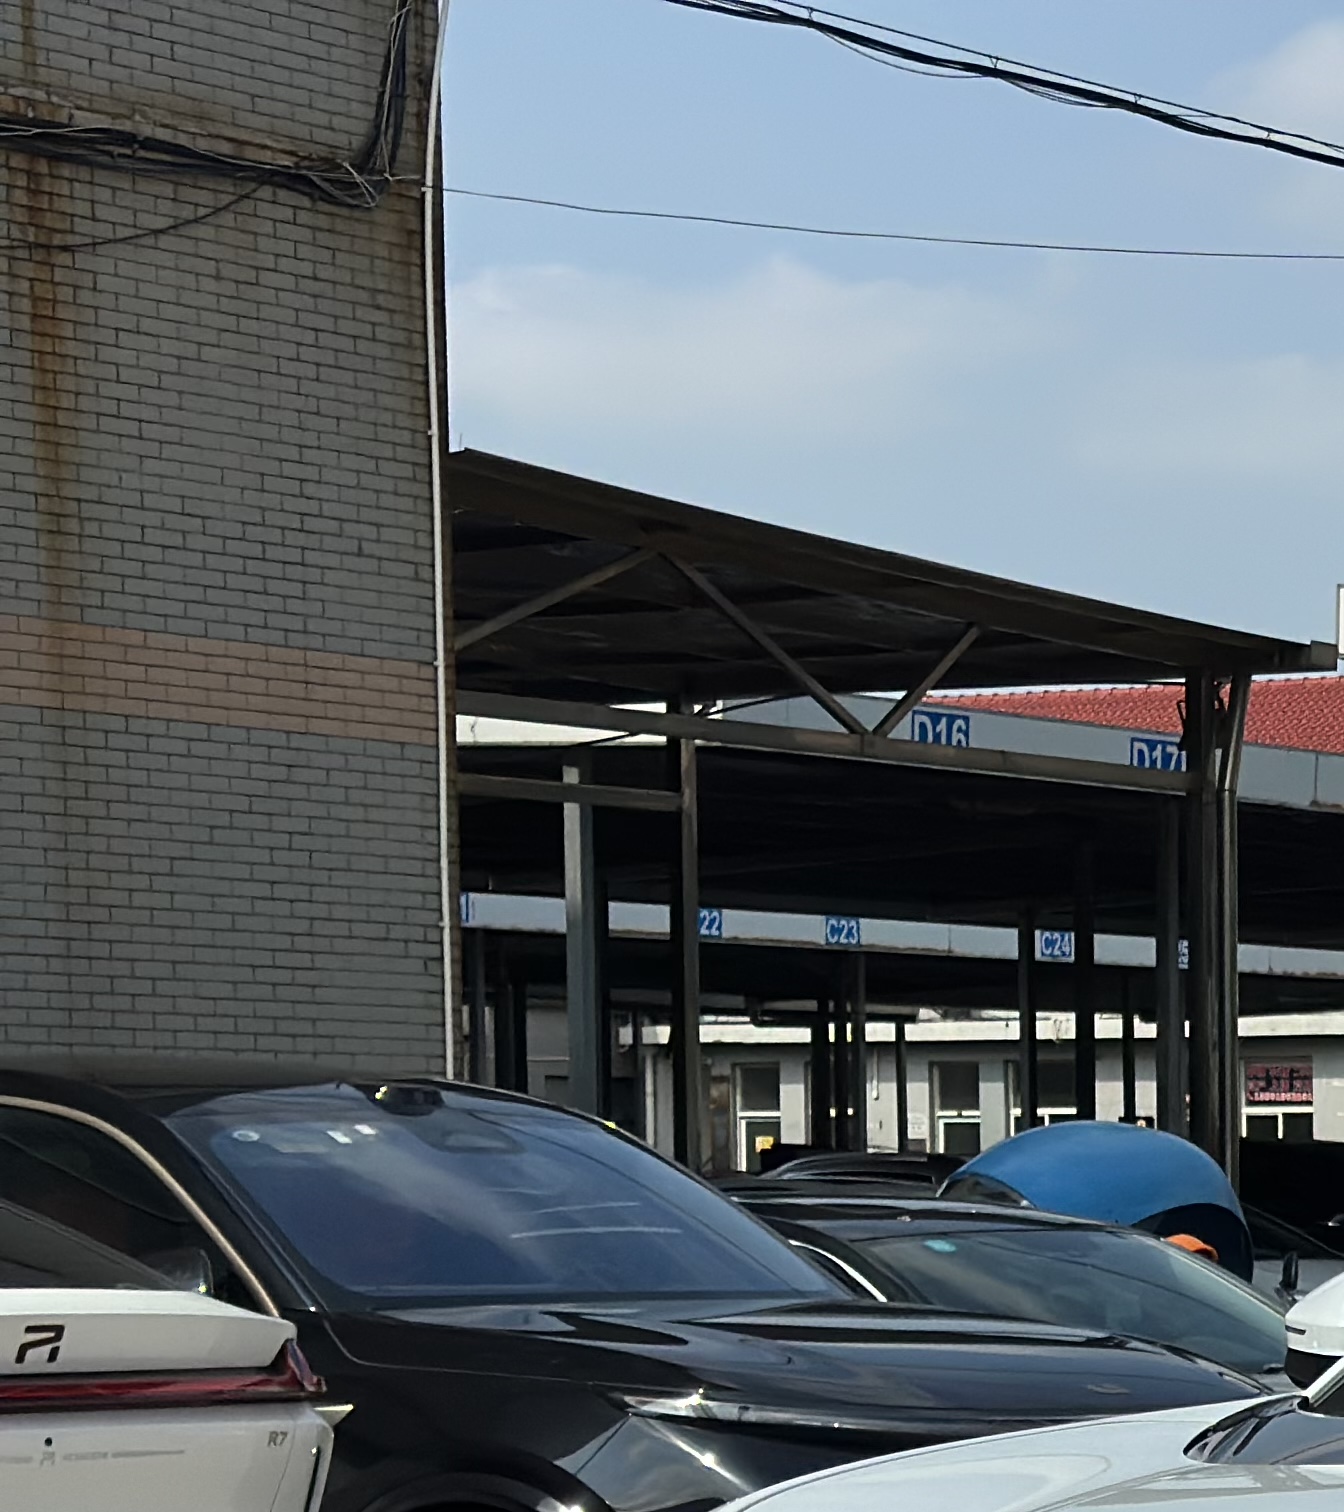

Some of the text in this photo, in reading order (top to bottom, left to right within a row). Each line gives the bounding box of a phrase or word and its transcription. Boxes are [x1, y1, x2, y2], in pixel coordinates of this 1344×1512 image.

[913, 714, 967, 748] D16
[700, 909, 721, 937] 22
[826, 917, 859, 945] C23
[1041, 931, 1071, 956] C24
[267, 1431, 288, 1448] R7
